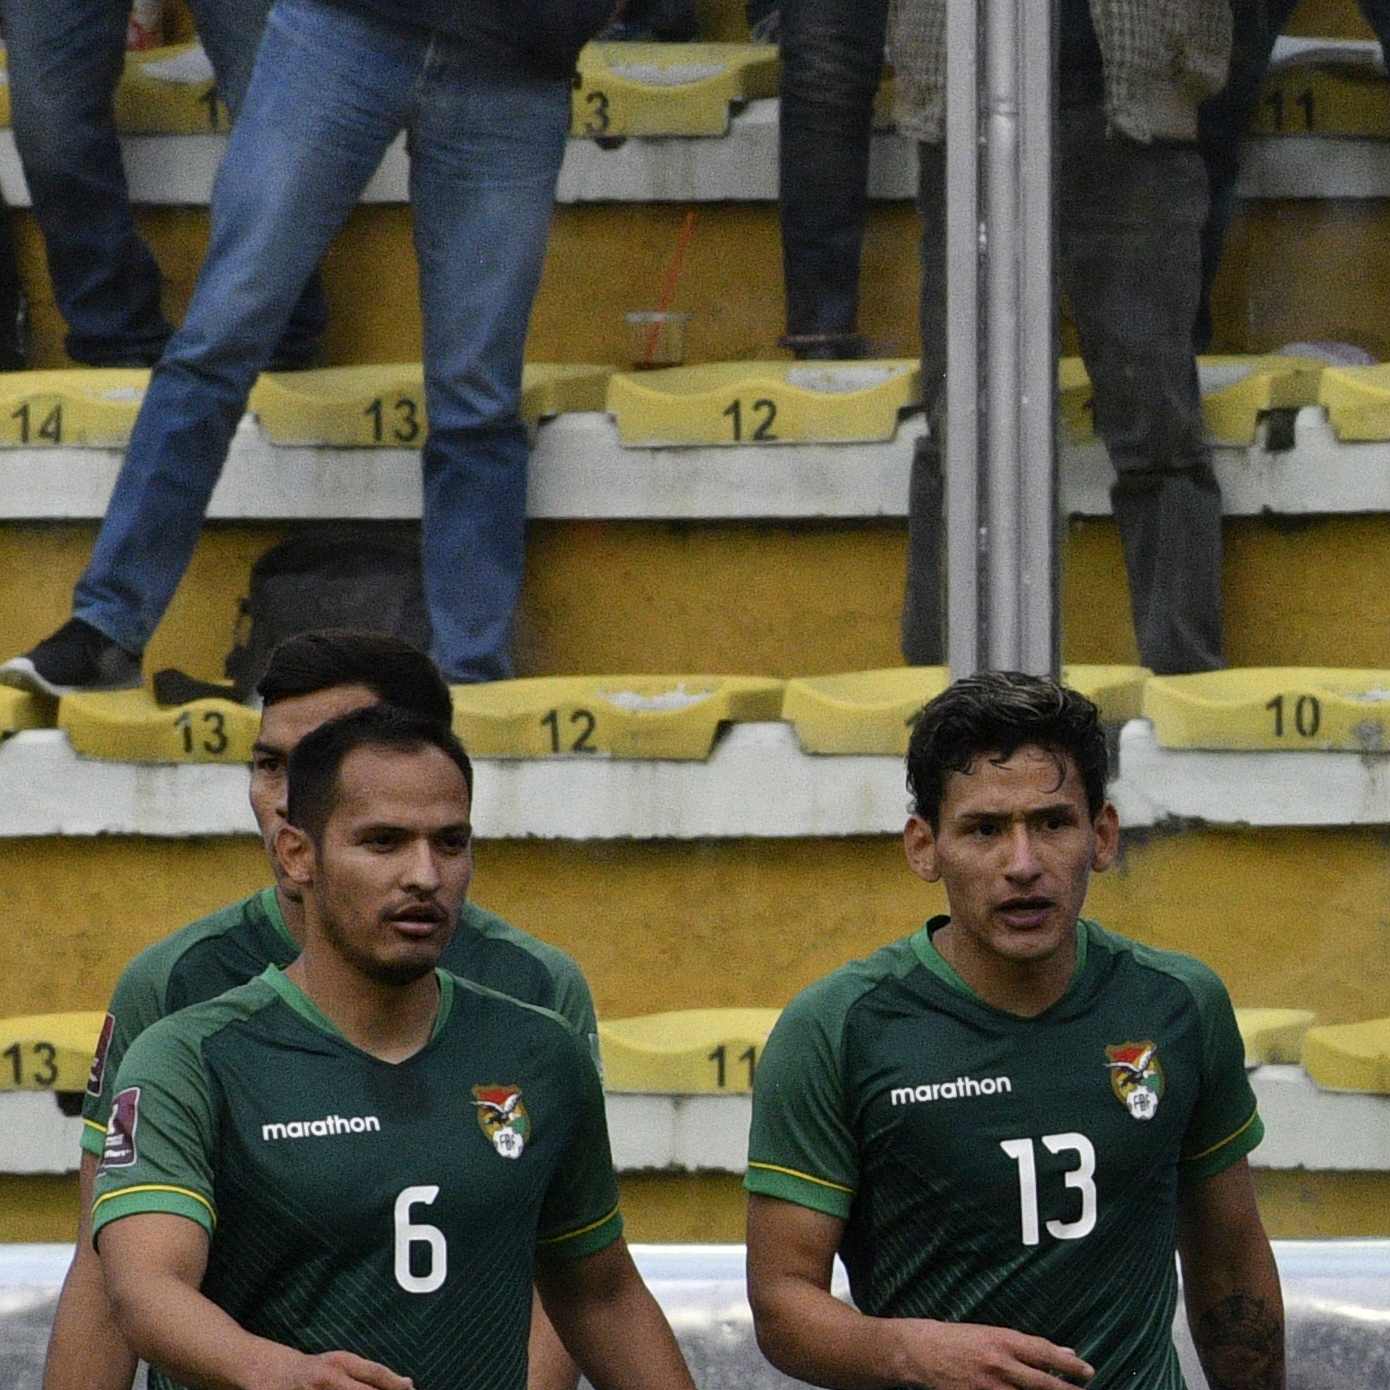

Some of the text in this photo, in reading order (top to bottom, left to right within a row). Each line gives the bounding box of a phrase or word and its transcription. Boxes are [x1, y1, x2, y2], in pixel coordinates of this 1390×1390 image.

[11, 404, 63, 443] 14
[364, 399, 421, 442] 13
[722, 399, 778, 442] 12
[173, 711, 228, 754] 13
[541, 709, 597, 753] 12
[1266, 695, 1322, 738] 10
[3, 1042, 58, 1087] 13
[708, 1045, 755, 1088] 11
[890, 1075, 1012, 1106] marathon
[262, 1114, 381, 1141] marathon
[1000, 1131, 1097, 1246] 13
[394, 1185, 447, 1293] 6
